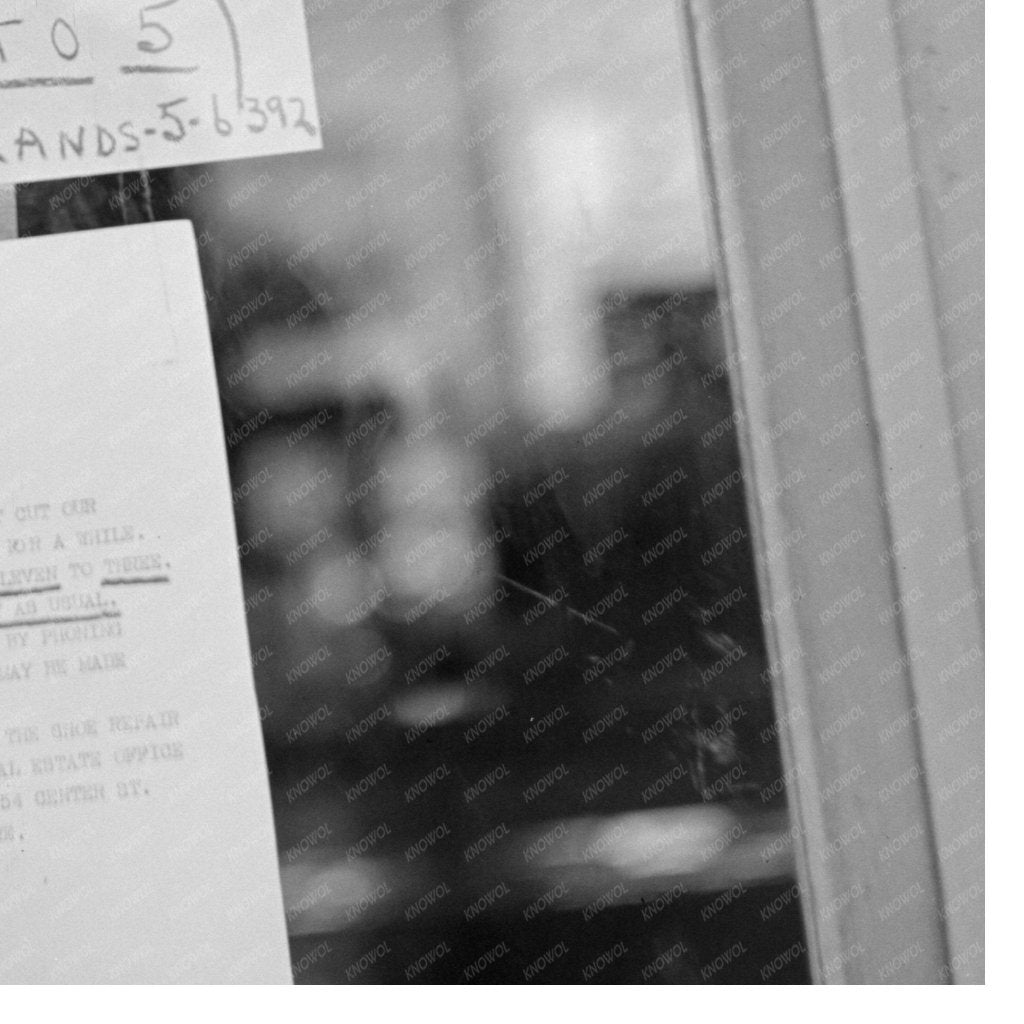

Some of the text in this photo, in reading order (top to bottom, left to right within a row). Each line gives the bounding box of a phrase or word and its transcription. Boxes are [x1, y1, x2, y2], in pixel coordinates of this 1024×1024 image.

[14, 502, 51, 523] CUT
[61, 497, 98, 518] OUR
[53, 533, 66, 551] A
[68, 561, 95, 578] TO
[7, 632, 31, 650] BY
[108, 709, 180, 734] REPAIR
[29, 750, 103, 777] ESTATE
[113, 741, 185, 765] OFFICE
